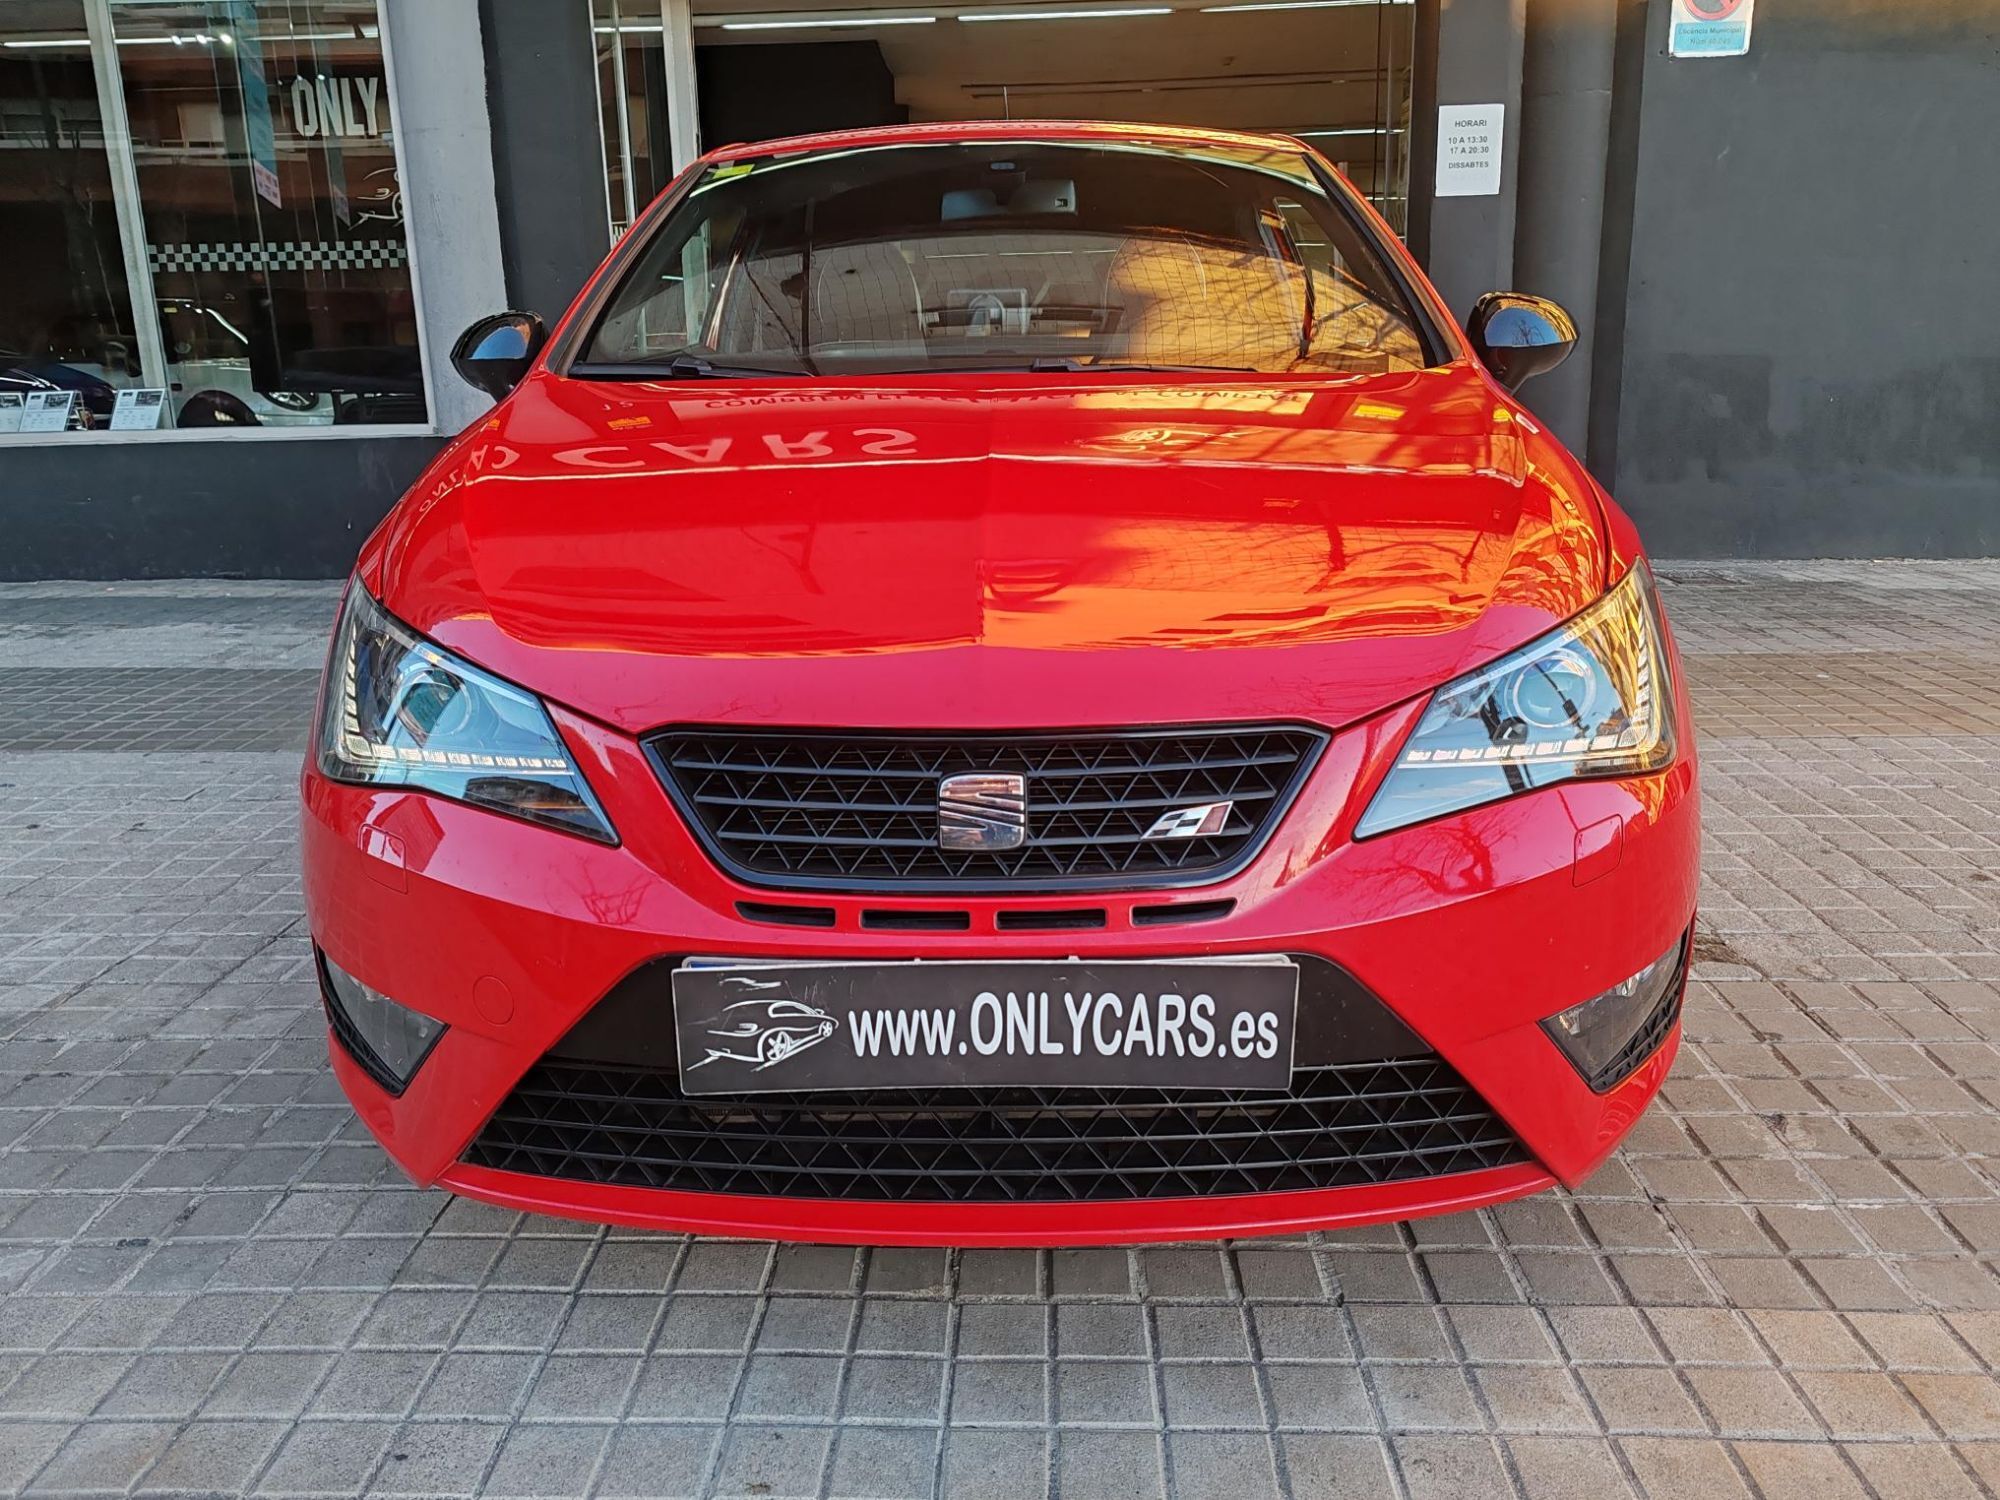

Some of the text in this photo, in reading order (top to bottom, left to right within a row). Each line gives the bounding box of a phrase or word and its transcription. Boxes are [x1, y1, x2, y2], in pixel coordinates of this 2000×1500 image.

[291, 77, 378, 137] ONLY
[1454, 119, 1487, 127] HORARI
[1448, 136, 1457, 144] 10
[1467, 135, 1488, 143] 13:30
[1468, 146, 1489, 154] 20:30
[1448, 160, 1489, 169] DISSABTES
[848, 992, 1279, 1059] www.ONLYCARS.es
